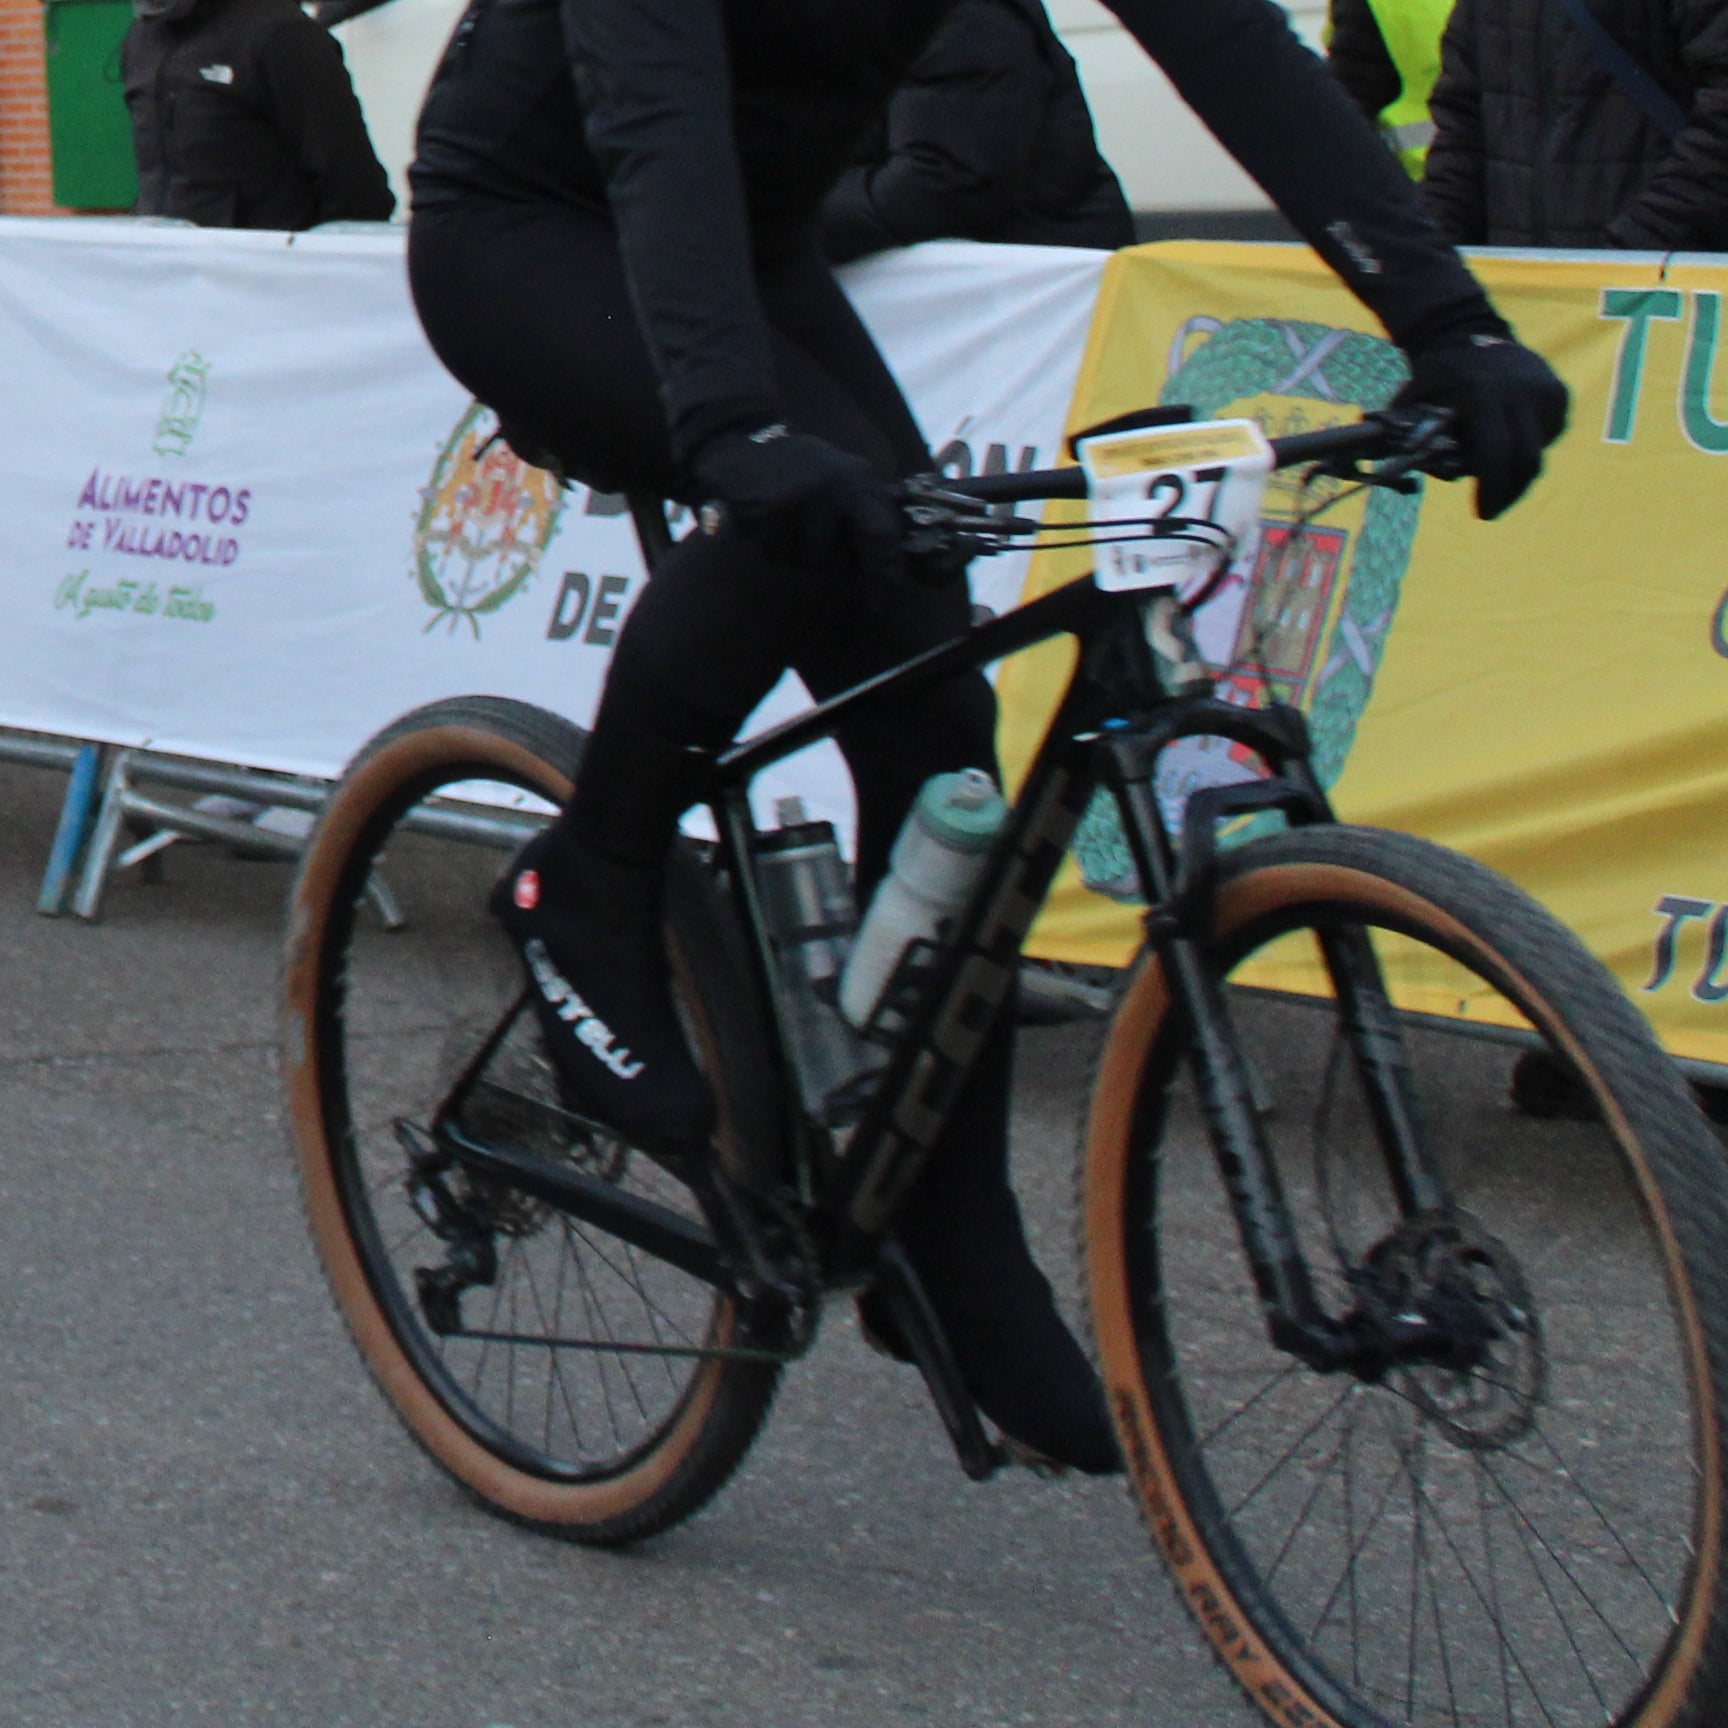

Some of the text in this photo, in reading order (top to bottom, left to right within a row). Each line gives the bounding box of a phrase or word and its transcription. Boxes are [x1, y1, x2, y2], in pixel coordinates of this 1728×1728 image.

[76, 466, 252, 526] ALIMENTOS
[1146, 466, 1228, 536] 27
[103, 517, 240, 567] VALLADOLID
